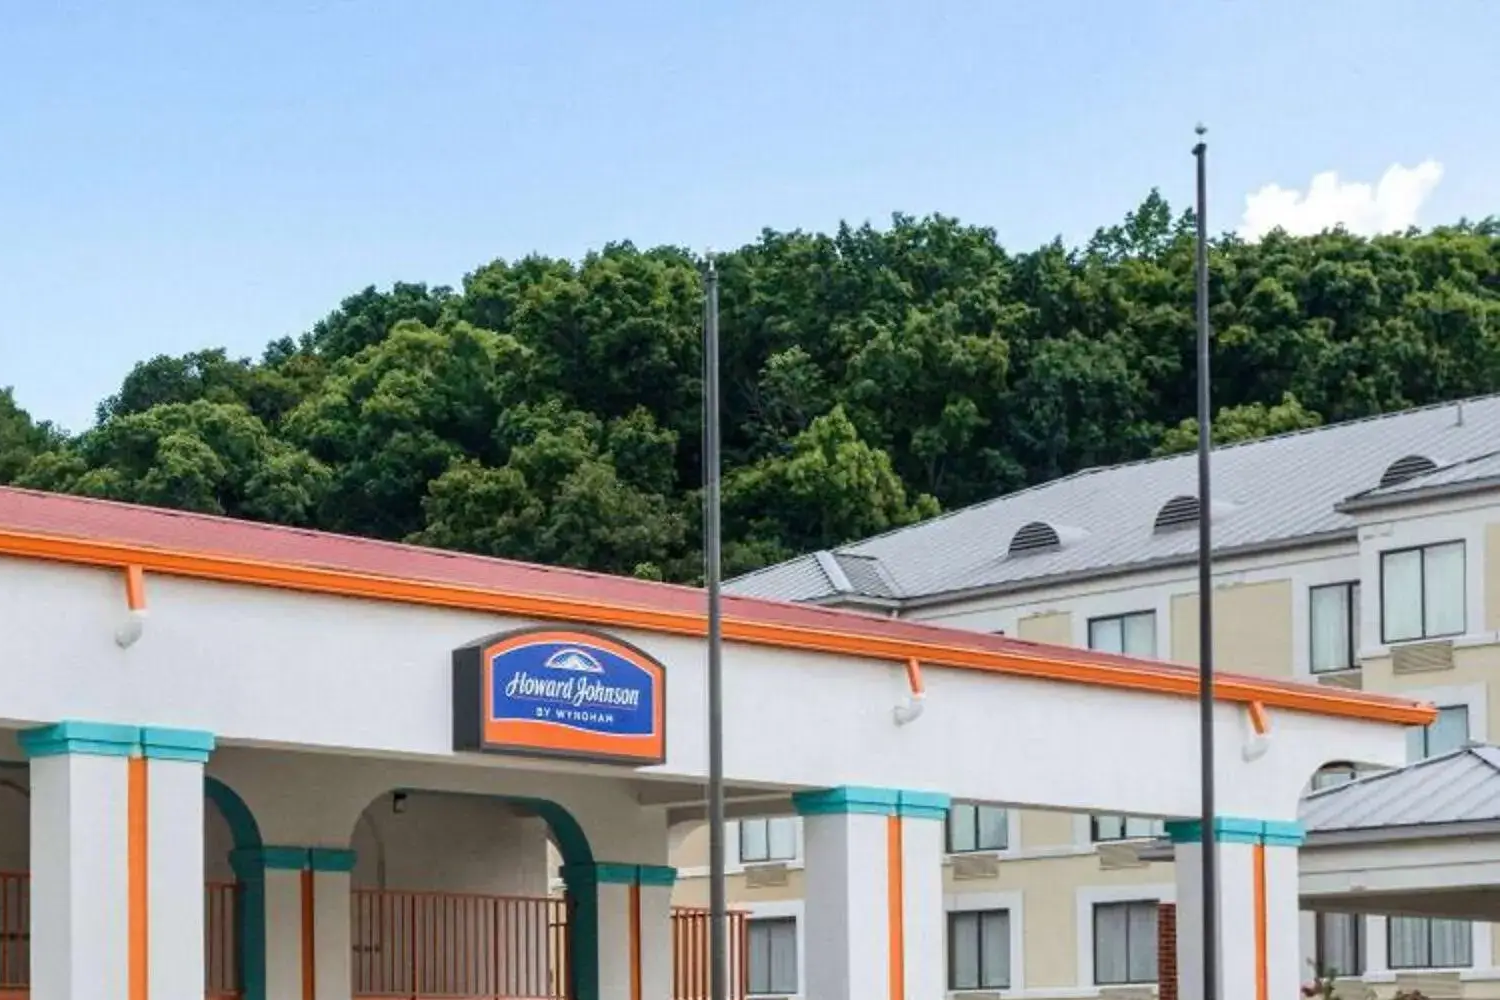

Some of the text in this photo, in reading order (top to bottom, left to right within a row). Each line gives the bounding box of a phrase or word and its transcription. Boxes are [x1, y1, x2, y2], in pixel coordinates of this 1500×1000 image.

[505, 671, 639, 706] Howard Johnson
[536, 707, 614, 723] BY WYNDHAM
